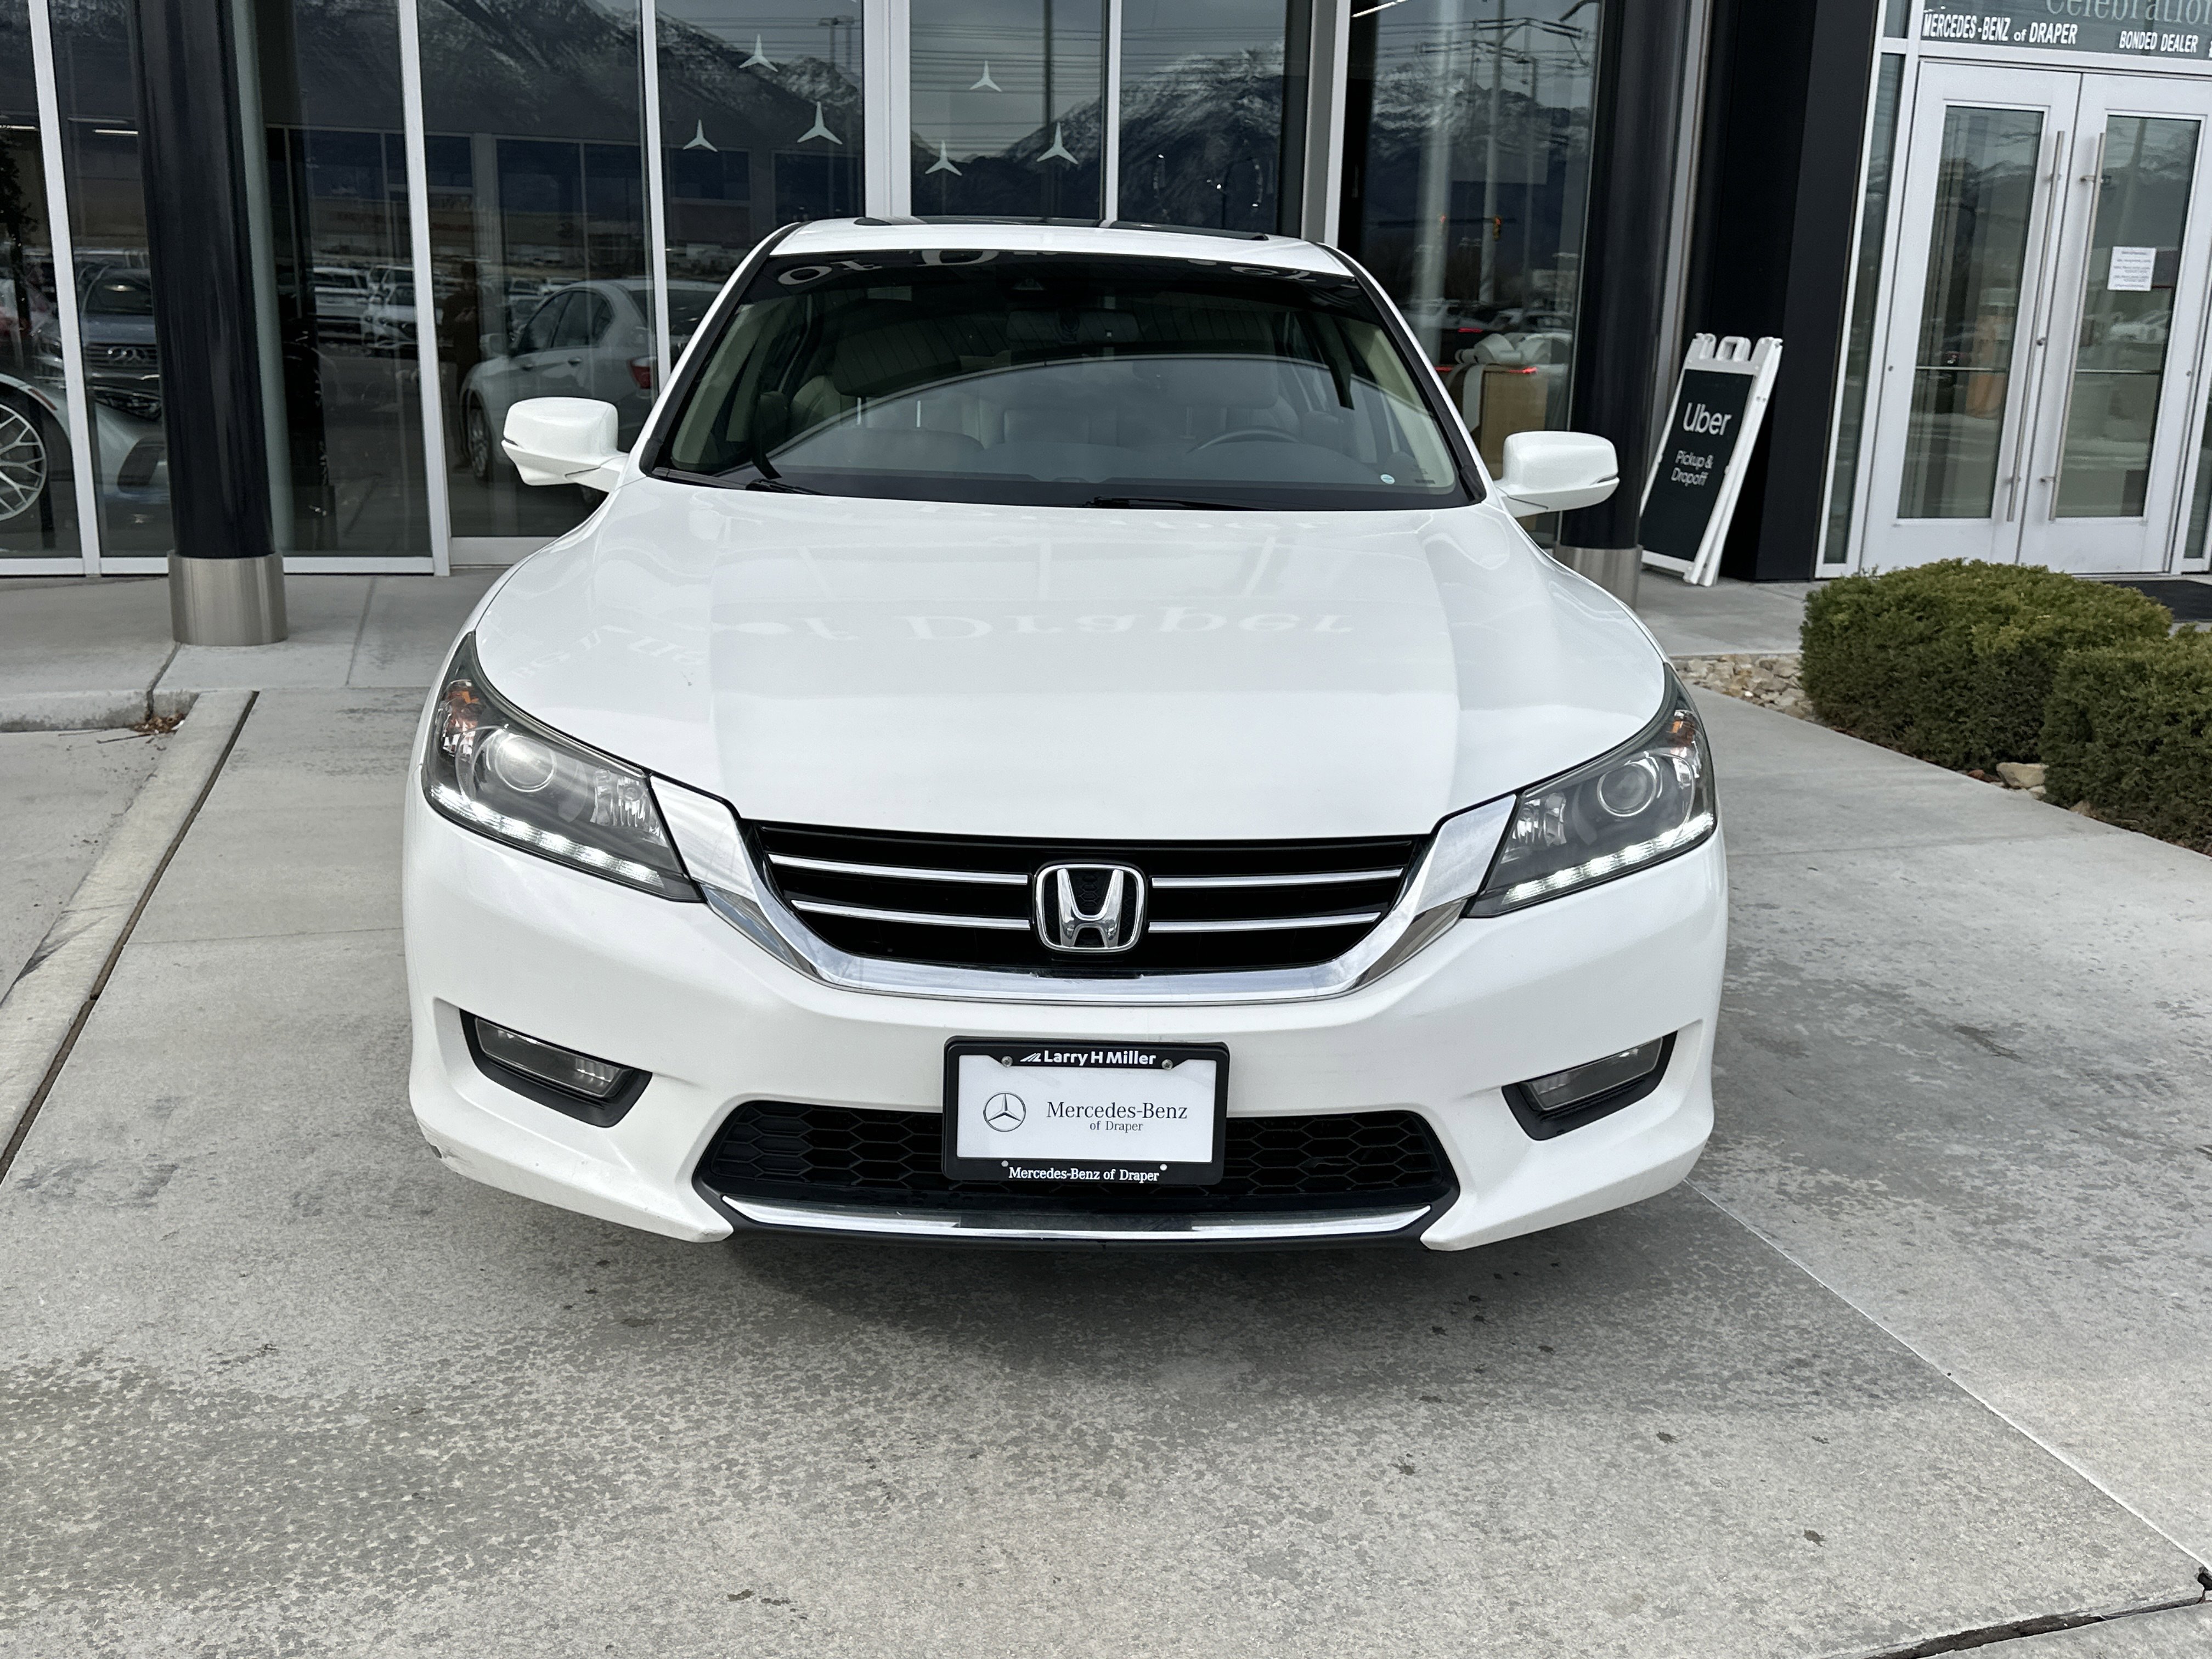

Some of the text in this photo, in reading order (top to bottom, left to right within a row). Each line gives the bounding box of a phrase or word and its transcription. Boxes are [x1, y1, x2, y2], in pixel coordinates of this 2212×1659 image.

[1922, 14, 2078, 44] MERCEDES-BENZ of DRAPER
[2119, 30, 2158, 50] BONDED
[2160, 33, 2199, 53] DEALER
[1683, 402, 1733, 435] Uber
[1675, 450, 1714, 471] Pickup &
[1671, 467, 1709, 487] Dropoff
[1043, 1050, 1156, 1066] Larry H Miller
[1046, 1101, 1188, 1119] Mercedes-Benz
[1090, 1120, 1144, 1133] of Draper
[1008, 1166, 1160, 1183] Mercedes-Benz of Draper
